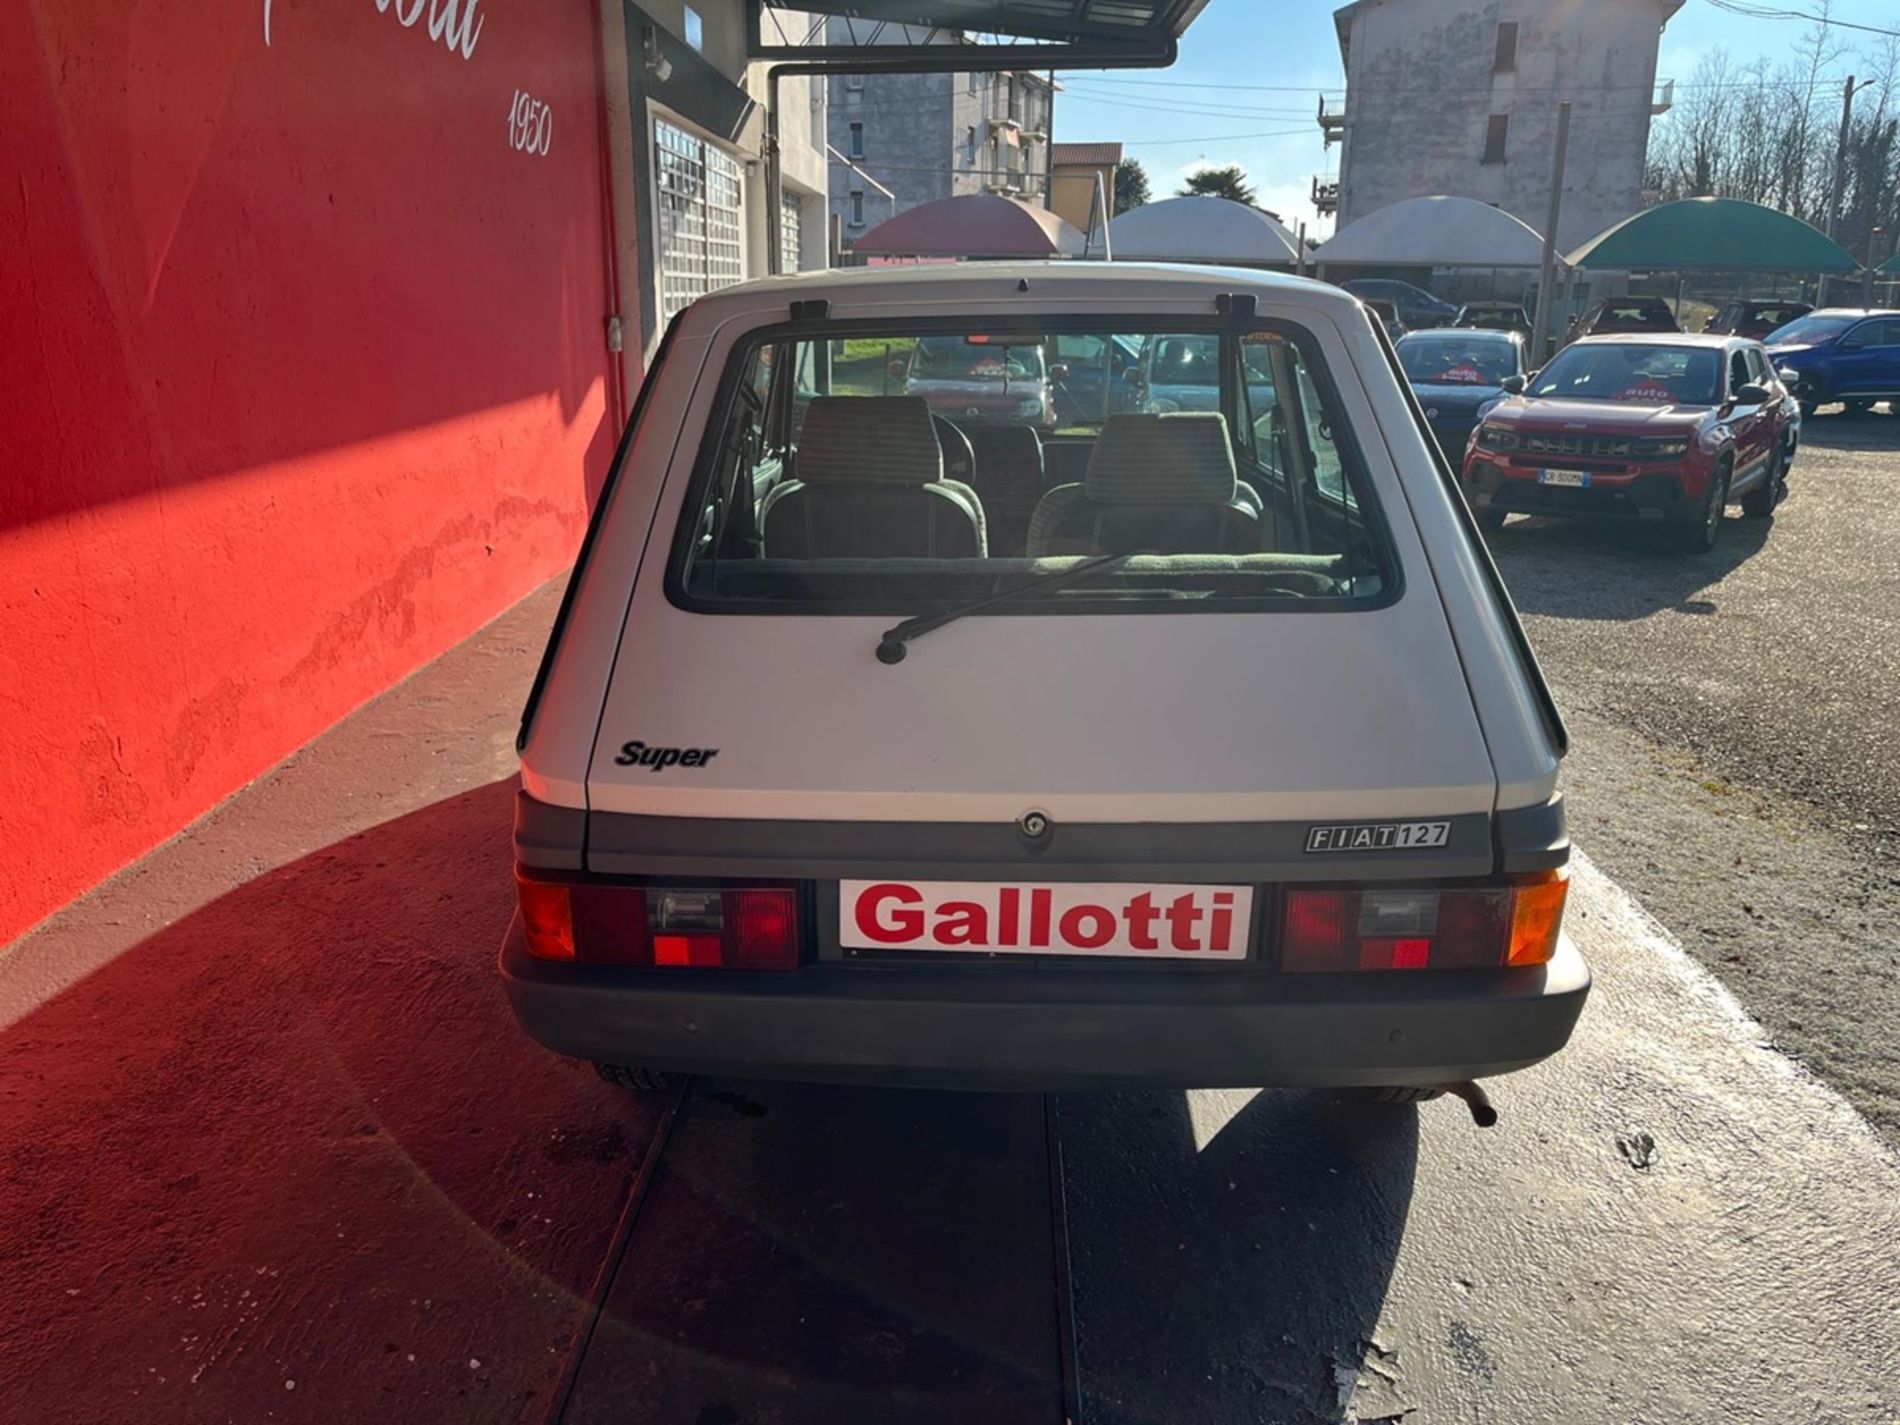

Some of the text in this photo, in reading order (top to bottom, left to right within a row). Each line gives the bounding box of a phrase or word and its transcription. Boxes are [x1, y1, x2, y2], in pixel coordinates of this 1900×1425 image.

[508, 88, 552, 156] 1950
[614, 740, 719, 773] Super
[1312, 824, 1447, 848] FIAT 127
[854, 882, 1235, 951] Gallotti
